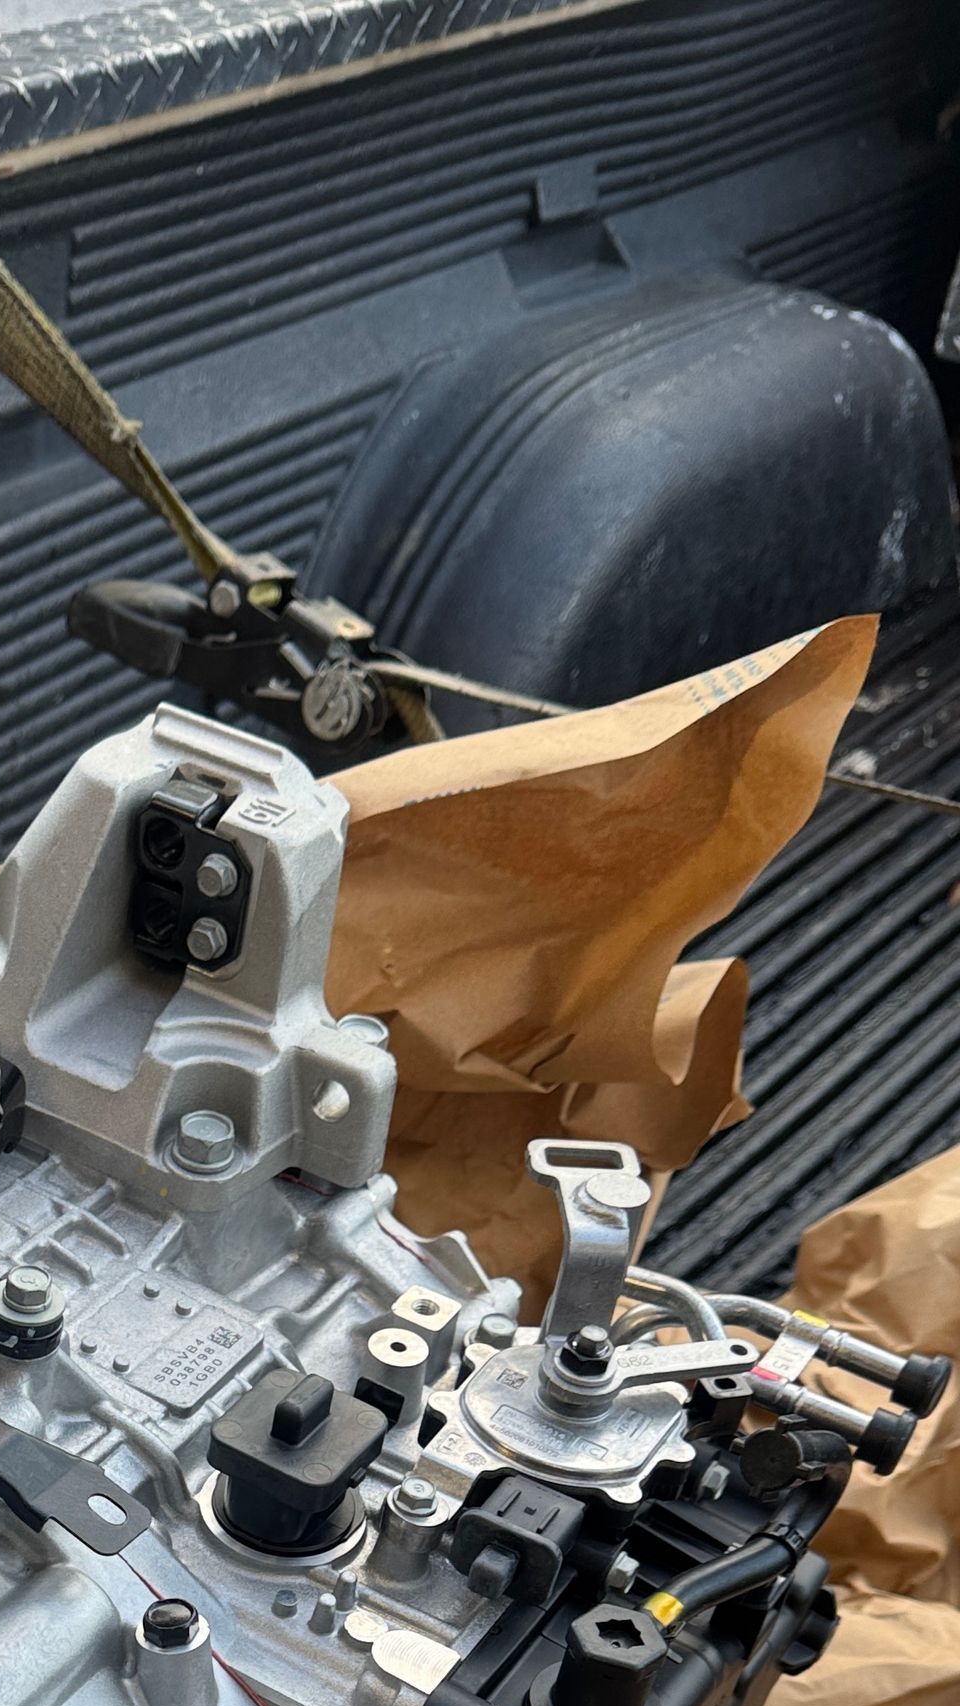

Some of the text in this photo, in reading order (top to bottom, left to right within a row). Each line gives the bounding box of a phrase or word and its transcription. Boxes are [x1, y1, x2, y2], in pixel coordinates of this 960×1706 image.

[153, 1338, 204, 1382] SBSVB4
[170, 1347, 215, 1386] 038798
[189, 1358, 223, 1387] 1GB0
